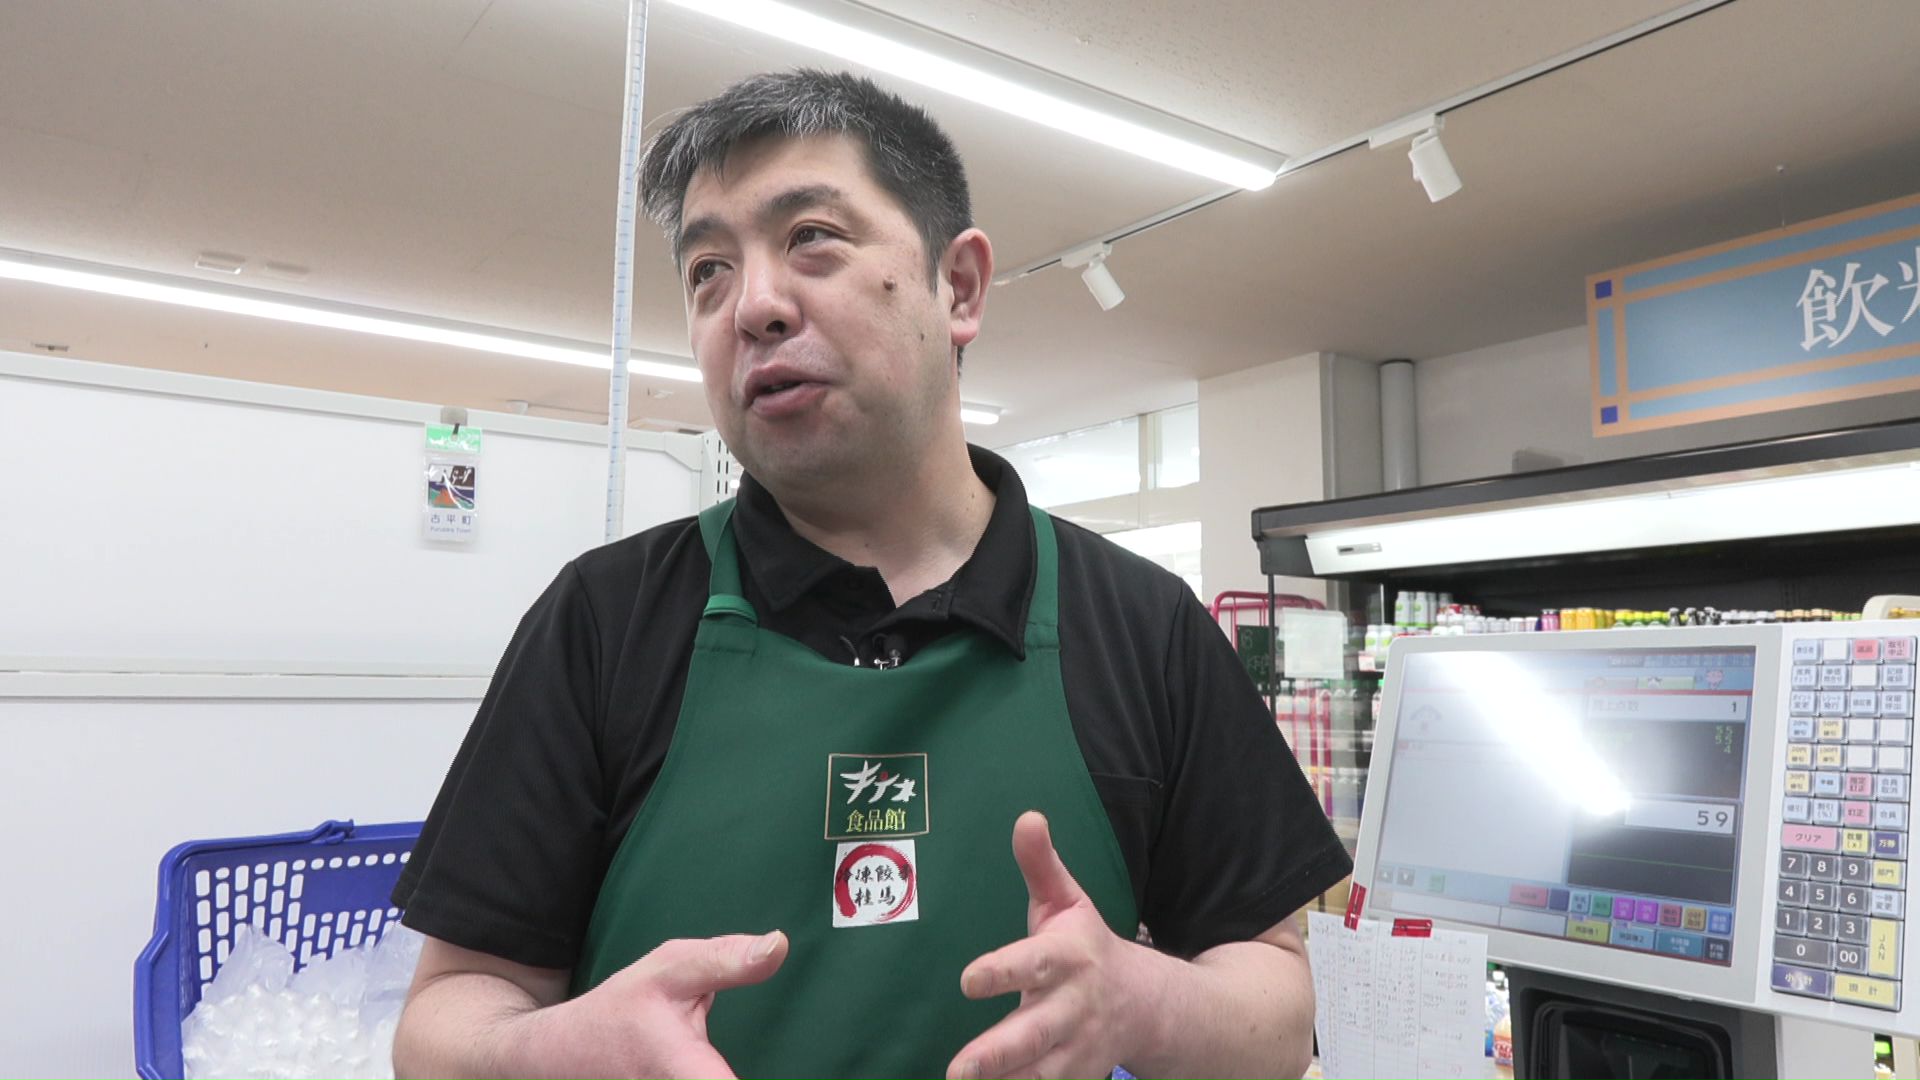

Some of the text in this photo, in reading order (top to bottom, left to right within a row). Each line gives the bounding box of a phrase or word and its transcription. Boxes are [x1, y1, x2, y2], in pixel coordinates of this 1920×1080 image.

[1796, 246, 1920, 351] 飲
[430, 514, 472, 525] 古平町
[846, 808, 907, 833] 食品館
[1697, 810, 1729, 828] 59
[1795, 833, 1822, 842] クリア
[1787, 857, 1796, 869] 7
[1817, 860, 1827, 872] 8
[1848, 863, 1859, 876] 9
[855, 885, 896, 907] 桂馬
[1785, 885, 1794, 897] 4
[1815, 888, 1825, 901] 5
[1847, 893, 1857, 904] 6
[1785, 913, 1790, 926] 1
[1813, 917, 1823, 930] 2
[1846, 921, 1856, 934] 3
[1796, 944, 1806, 957] 0
[1878, 934, 1887, 960] JAN
[1839, 950, 1858, 964] 00
